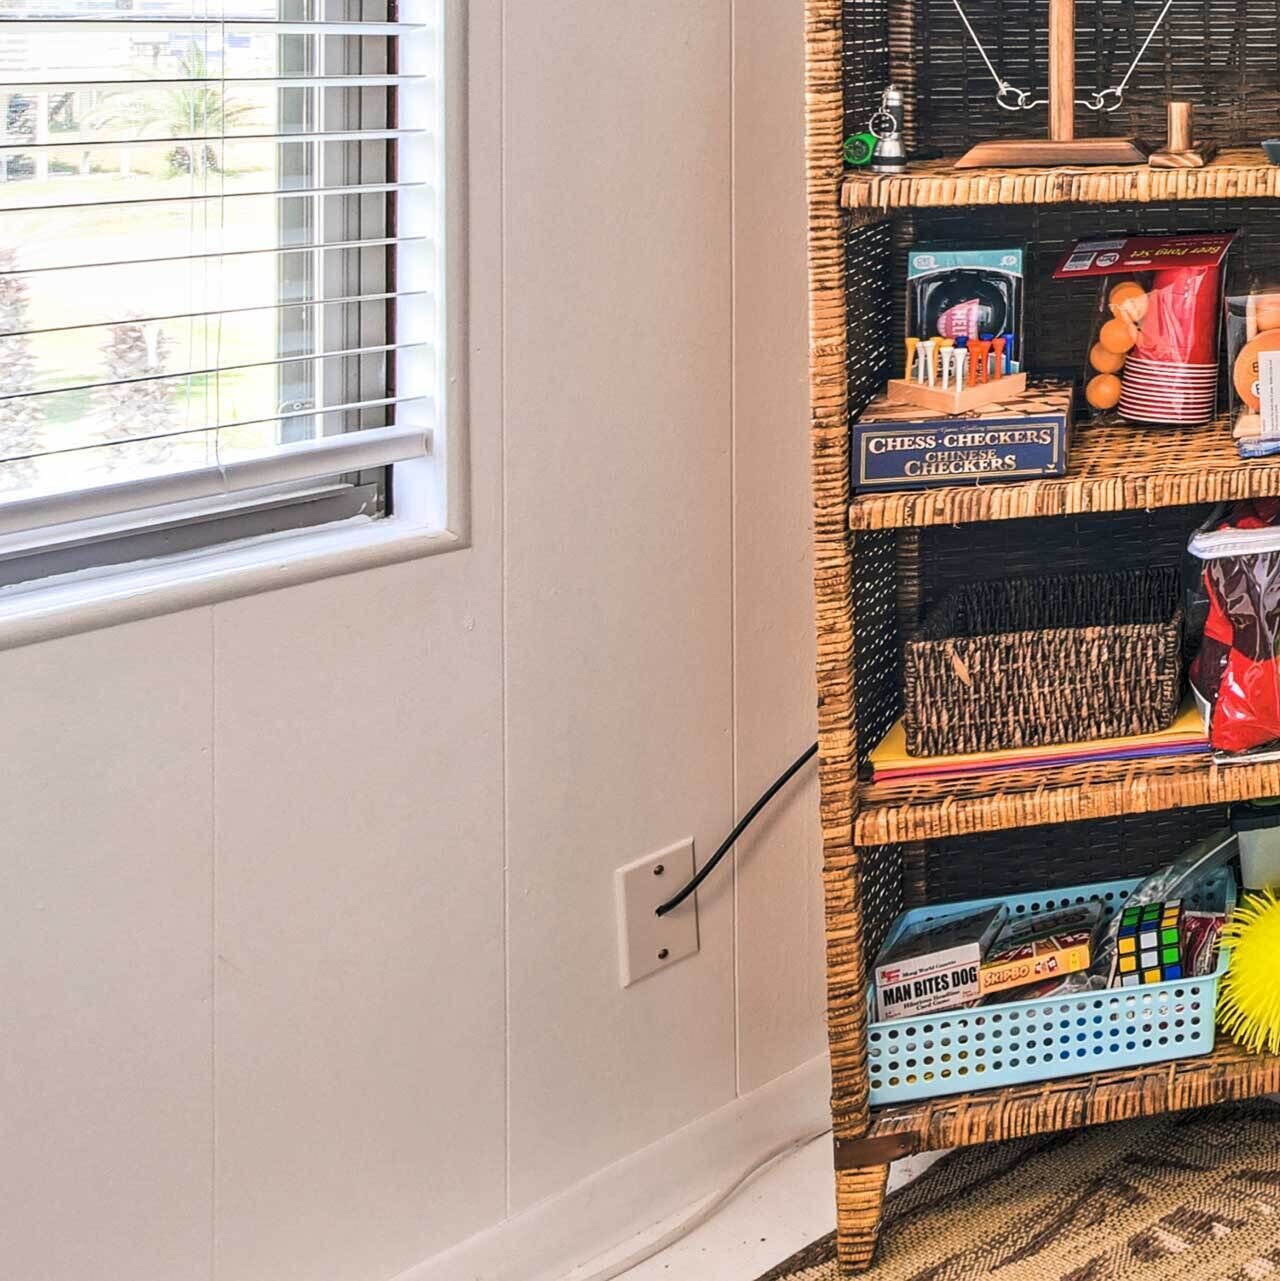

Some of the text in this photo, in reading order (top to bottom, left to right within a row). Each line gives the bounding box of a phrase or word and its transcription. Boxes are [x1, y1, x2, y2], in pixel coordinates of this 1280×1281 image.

[868, 429, 1051, 454] CHESS CHECKERS
[904, 454, 1017, 476] CHECKERS
[925, 448, 997, 463] CHINESE
[882, 983, 912, 1007] MAN
[913, 973, 950, 998] BITES
[951, 966, 978, 987] DOG
[916, 1003, 932, 1011] Card
